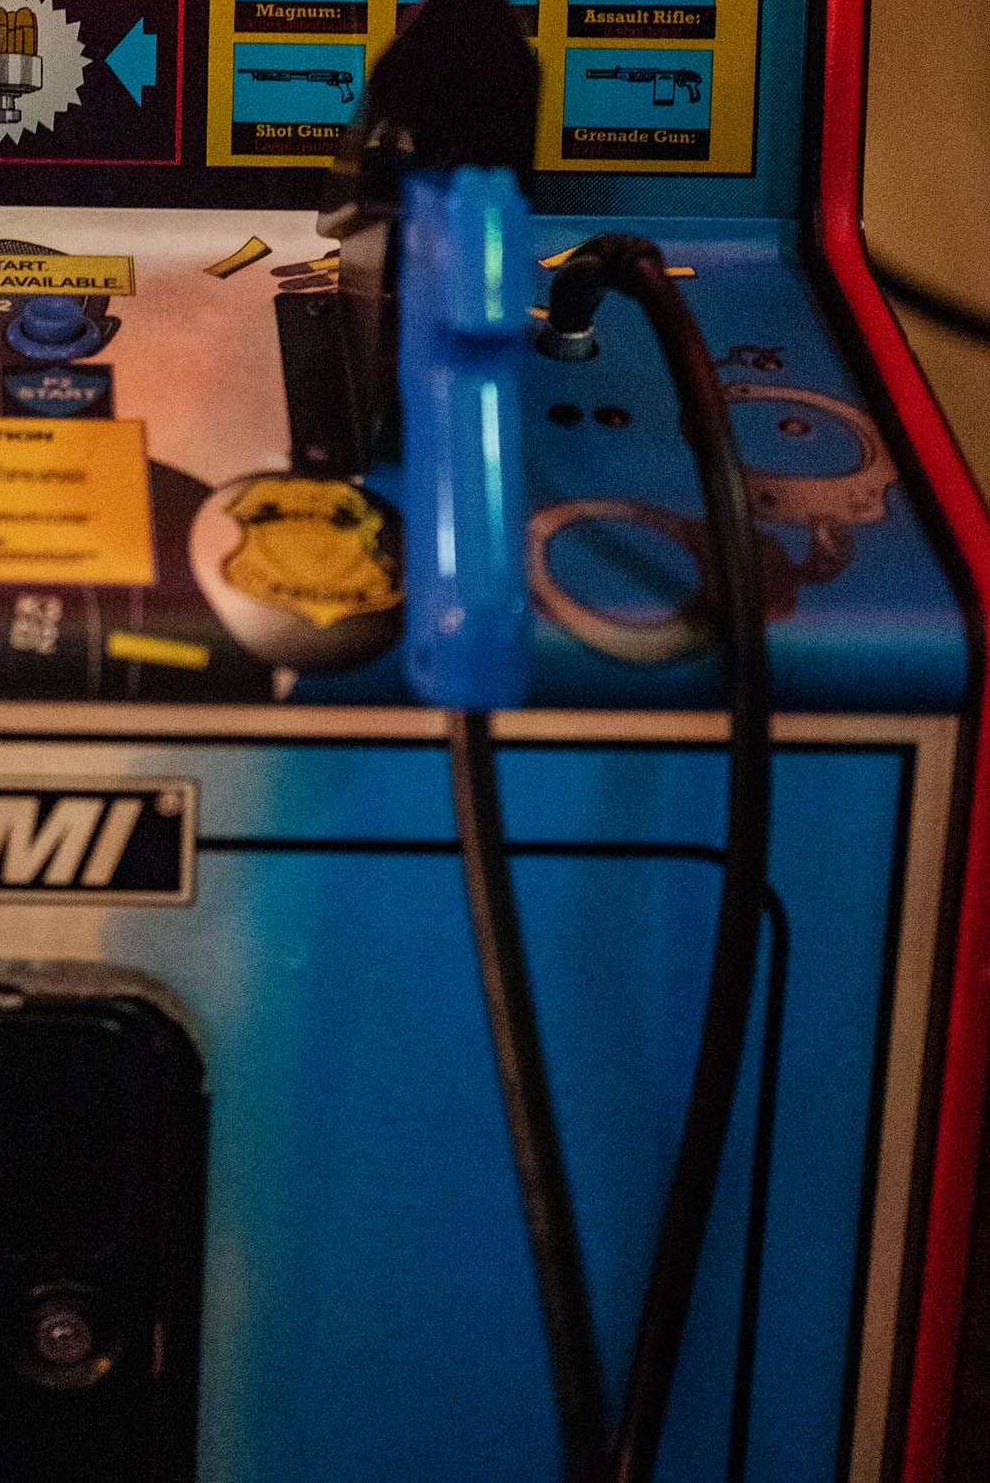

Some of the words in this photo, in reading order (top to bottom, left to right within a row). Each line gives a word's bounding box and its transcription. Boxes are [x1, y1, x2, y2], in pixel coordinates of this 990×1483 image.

[256, 4, 341, 20] Magnum:
[584, 10, 649, 24] Assault
[653, 10, 701, 24] Rifle:
[256, 124, 293, 138] Shot
[297, 125, 340, 138] Gun:
[574, 128, 649, 142] Grenade
[653, 130, 696, 144] Gun:
